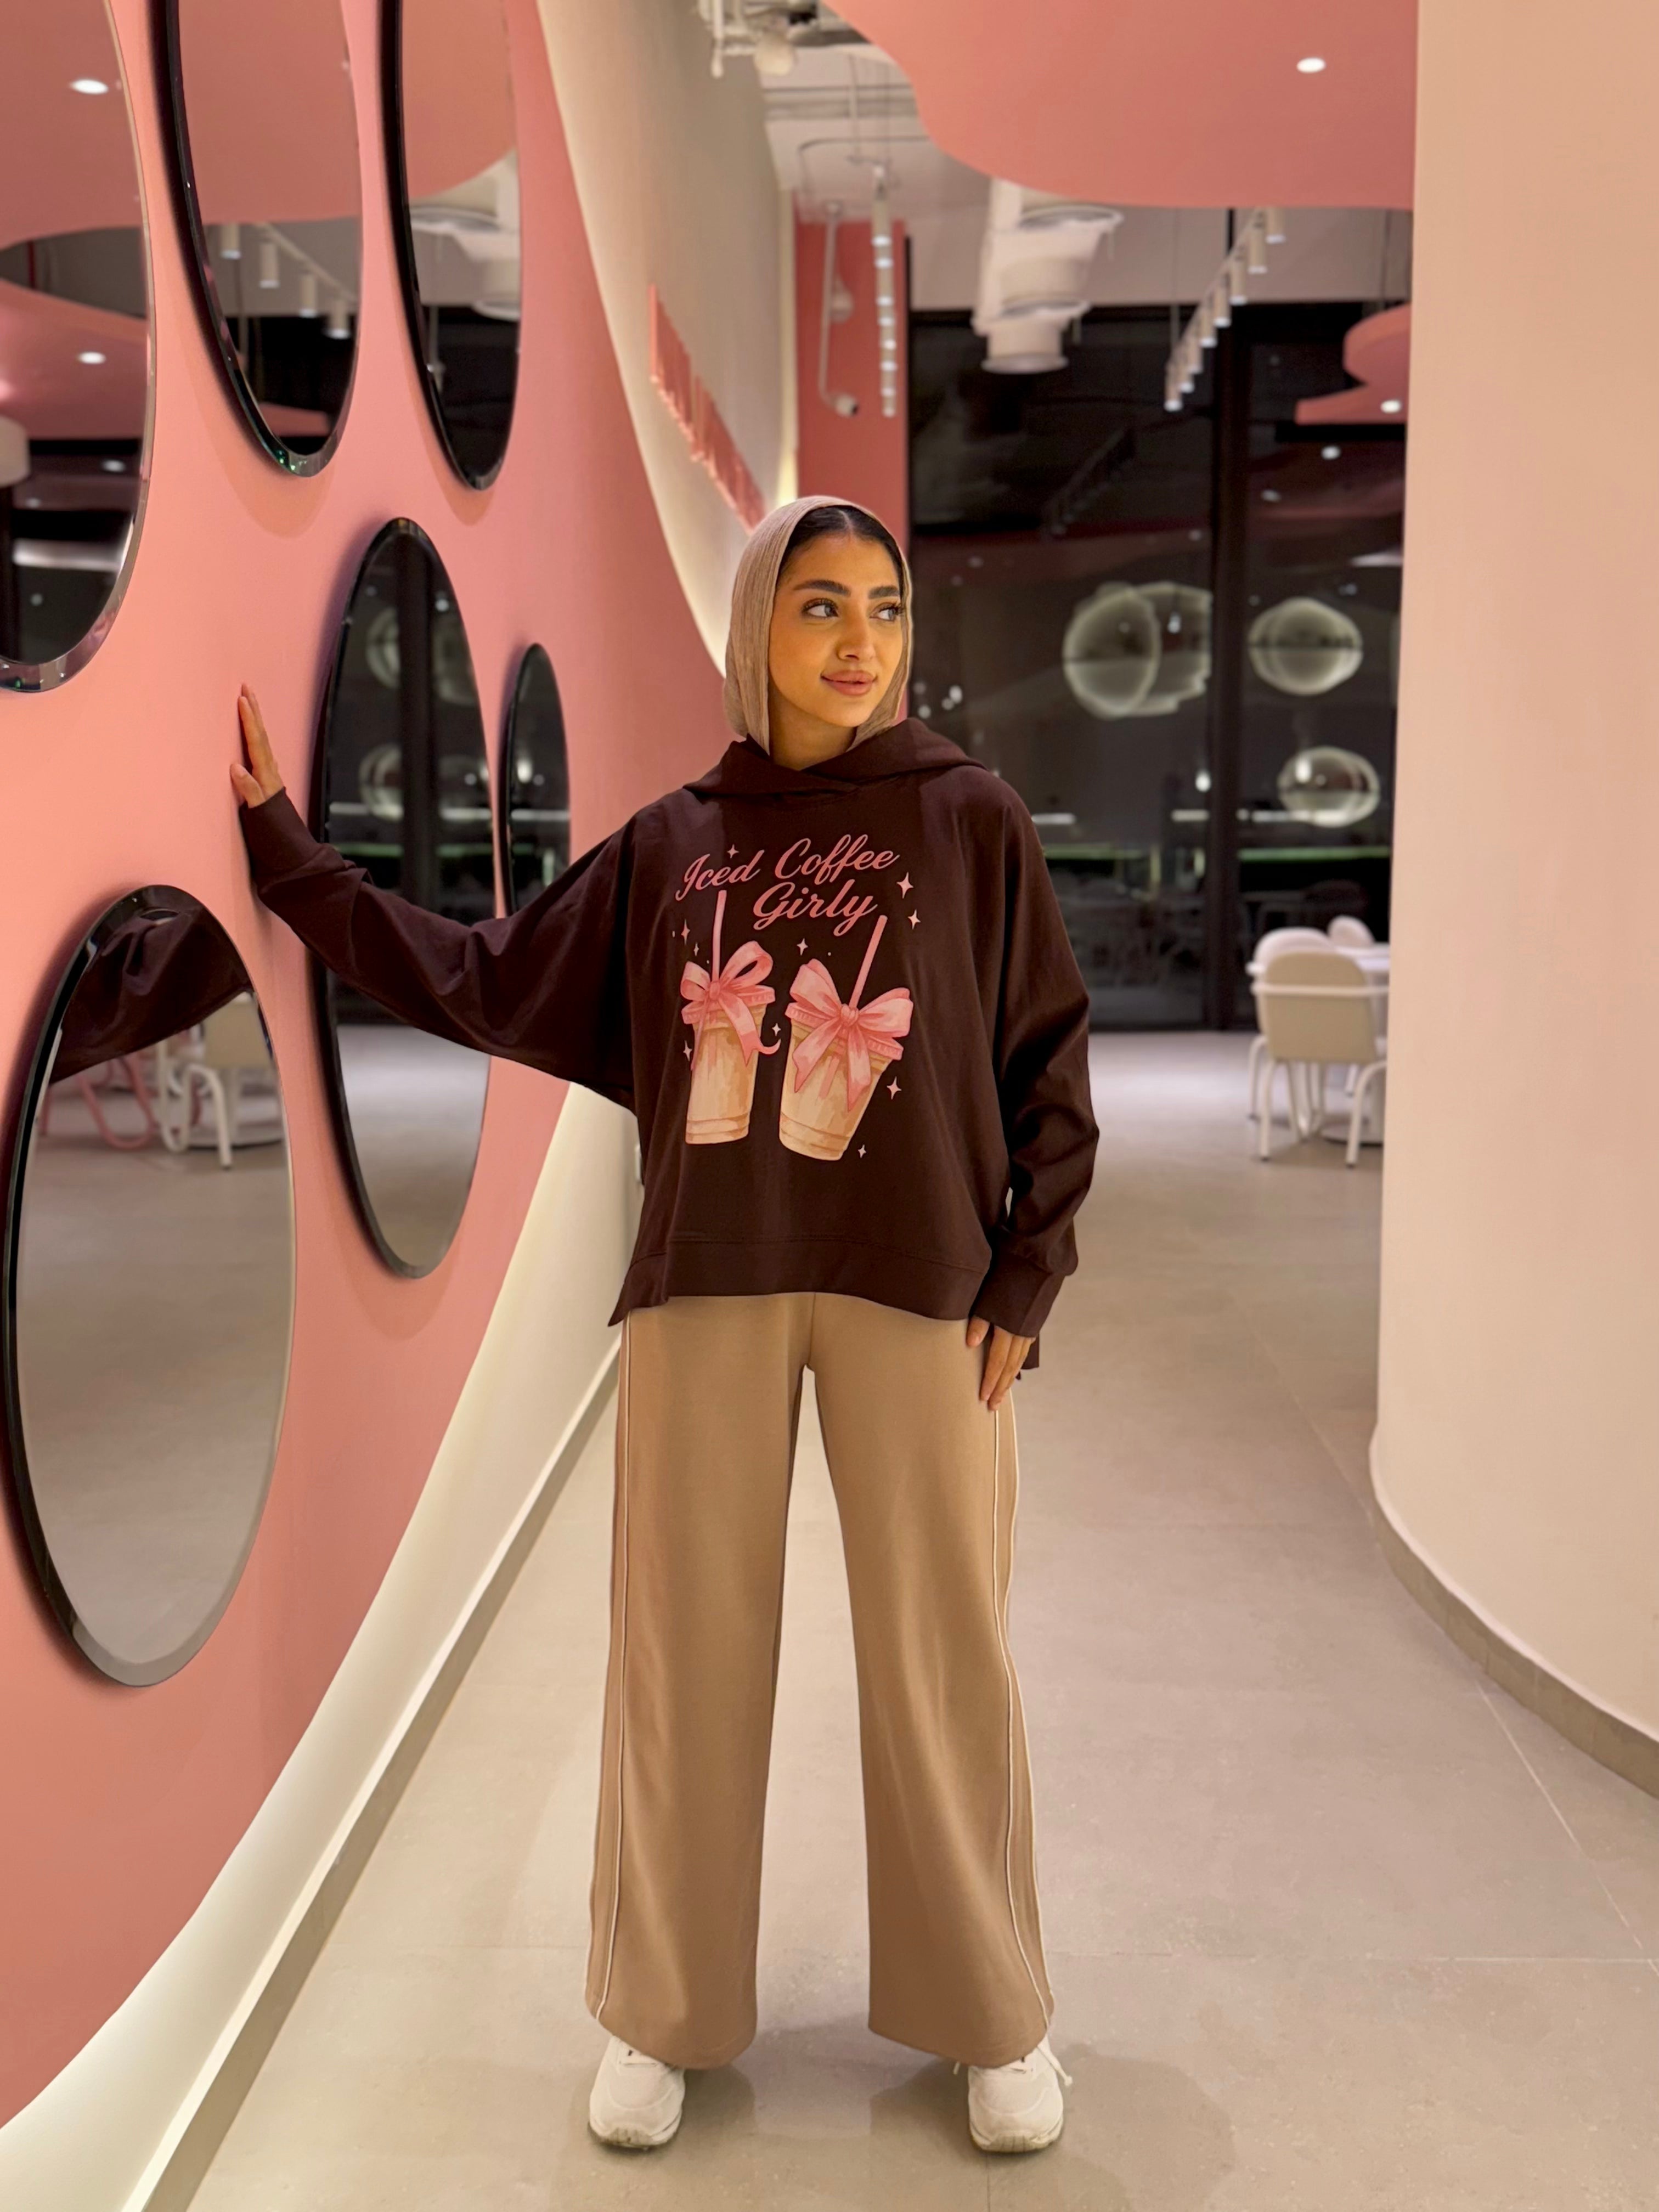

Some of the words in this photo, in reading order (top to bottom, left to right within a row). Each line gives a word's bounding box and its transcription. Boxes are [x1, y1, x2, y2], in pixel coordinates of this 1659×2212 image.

[675, 850, 765, 901] Iced
[775, 834, 900, 885] Coffee
[753, 879, 878, 936] Girly
